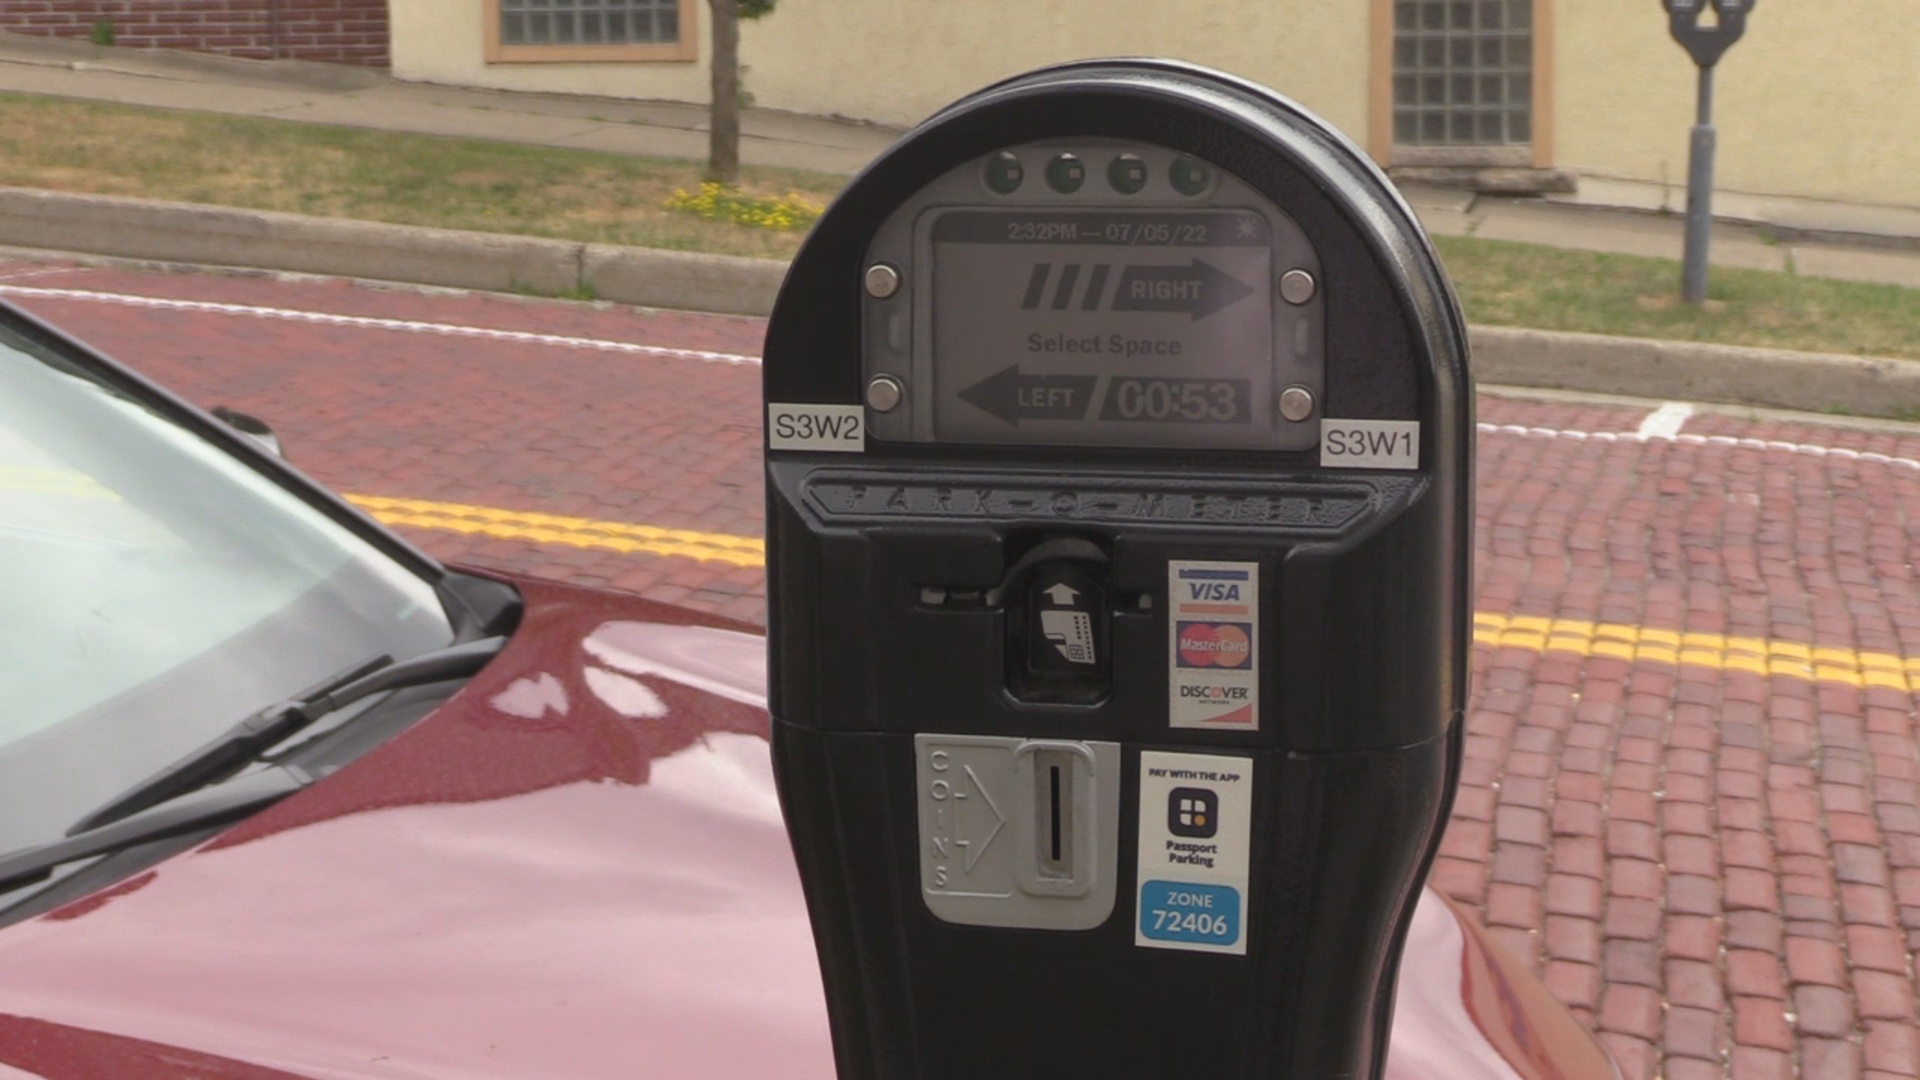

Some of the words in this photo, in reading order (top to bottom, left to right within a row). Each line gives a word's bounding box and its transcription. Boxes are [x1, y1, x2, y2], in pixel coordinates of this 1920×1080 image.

[1008, 222, 1077, 241] 2:32PM
[1106, 223, 1206, 246] 07/05/22
[1131, 280, 1202, 300] RIGHT
[1028, 333, 1101, 354] Select
[1109, 335, 1182, 358] Space
[1018, 389, 1074, 408] LEFT
[1117, 380, 1237, 420] 00:53
[776, 413, 859, 440] S3W2
[1326, 429, 1411, 456] S3W1
[1190, 583, 1240, 600] VISA
[1180, 638, 1248, 651] MasterCard
[1180, 685, 1248, 699] DISCOVER
[1149, 768, 1167, 777] PAY
[1169, 769, 1197, 779] WITH
[1199, 772, 1217, 781] THE
[1219, 773, 1240, 782] APP
[1166, 840, 1217, 855] Passport
[1169, 854, 1214, 868] Parking
[1167, 892, 1213, 908] ZONE
[1152, 909, 1228, 936] 72406
